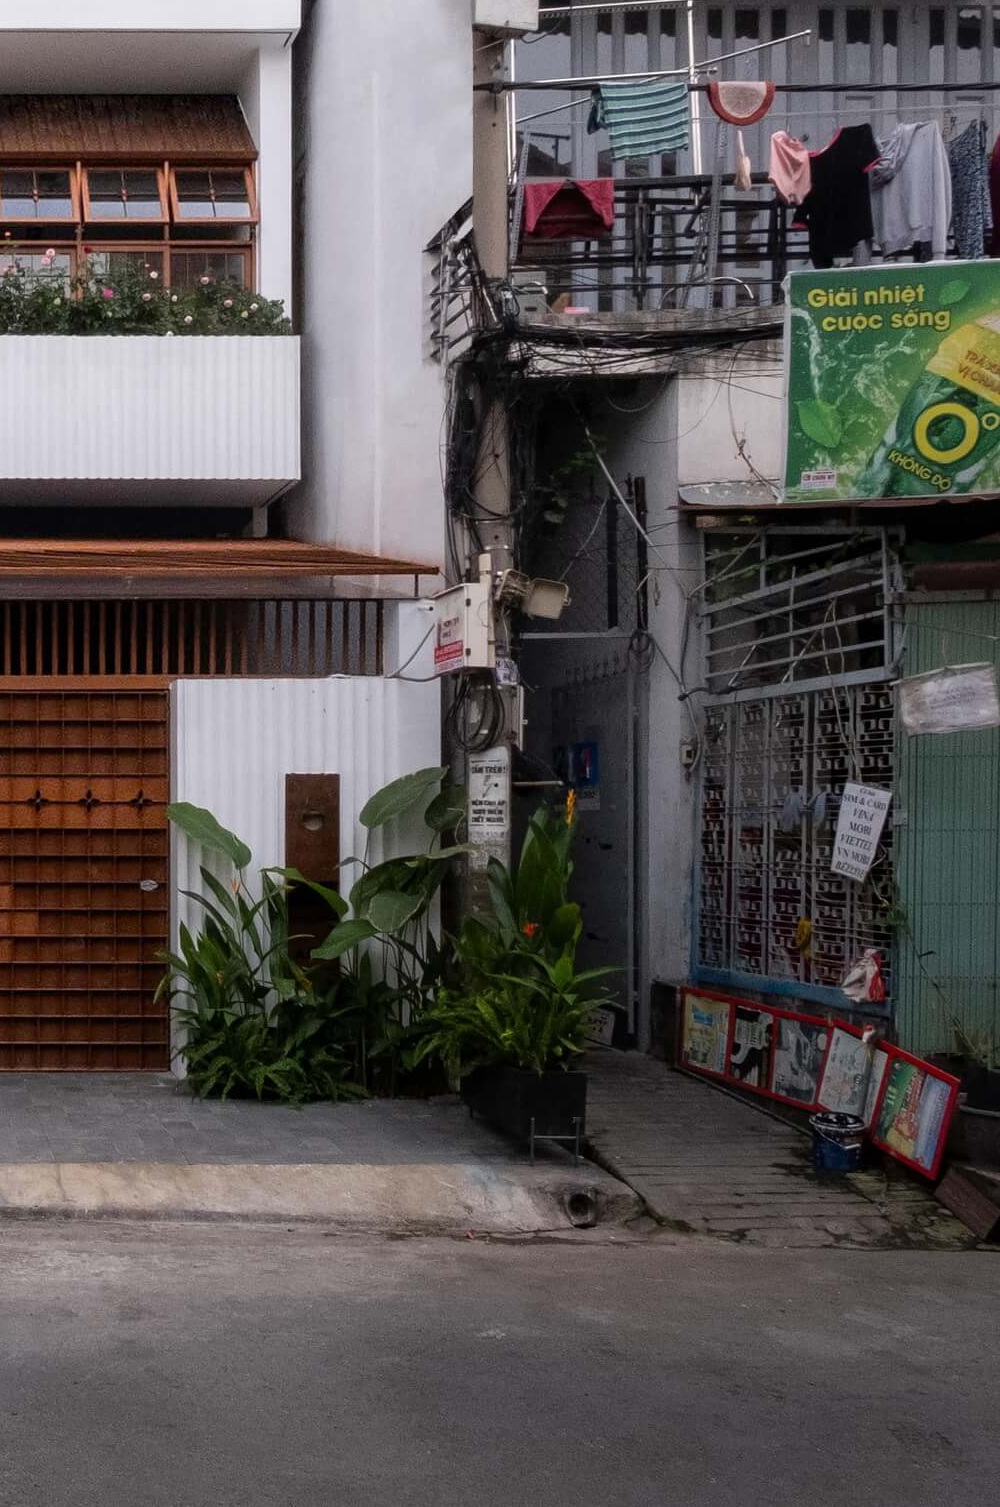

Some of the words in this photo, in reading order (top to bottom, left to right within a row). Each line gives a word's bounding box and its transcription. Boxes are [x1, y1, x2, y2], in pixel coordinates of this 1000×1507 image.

[863, 284, 925, 308] nhiệt
[822, 312, 883, 332] cuộc
[891, 307, 951, 331] sống
